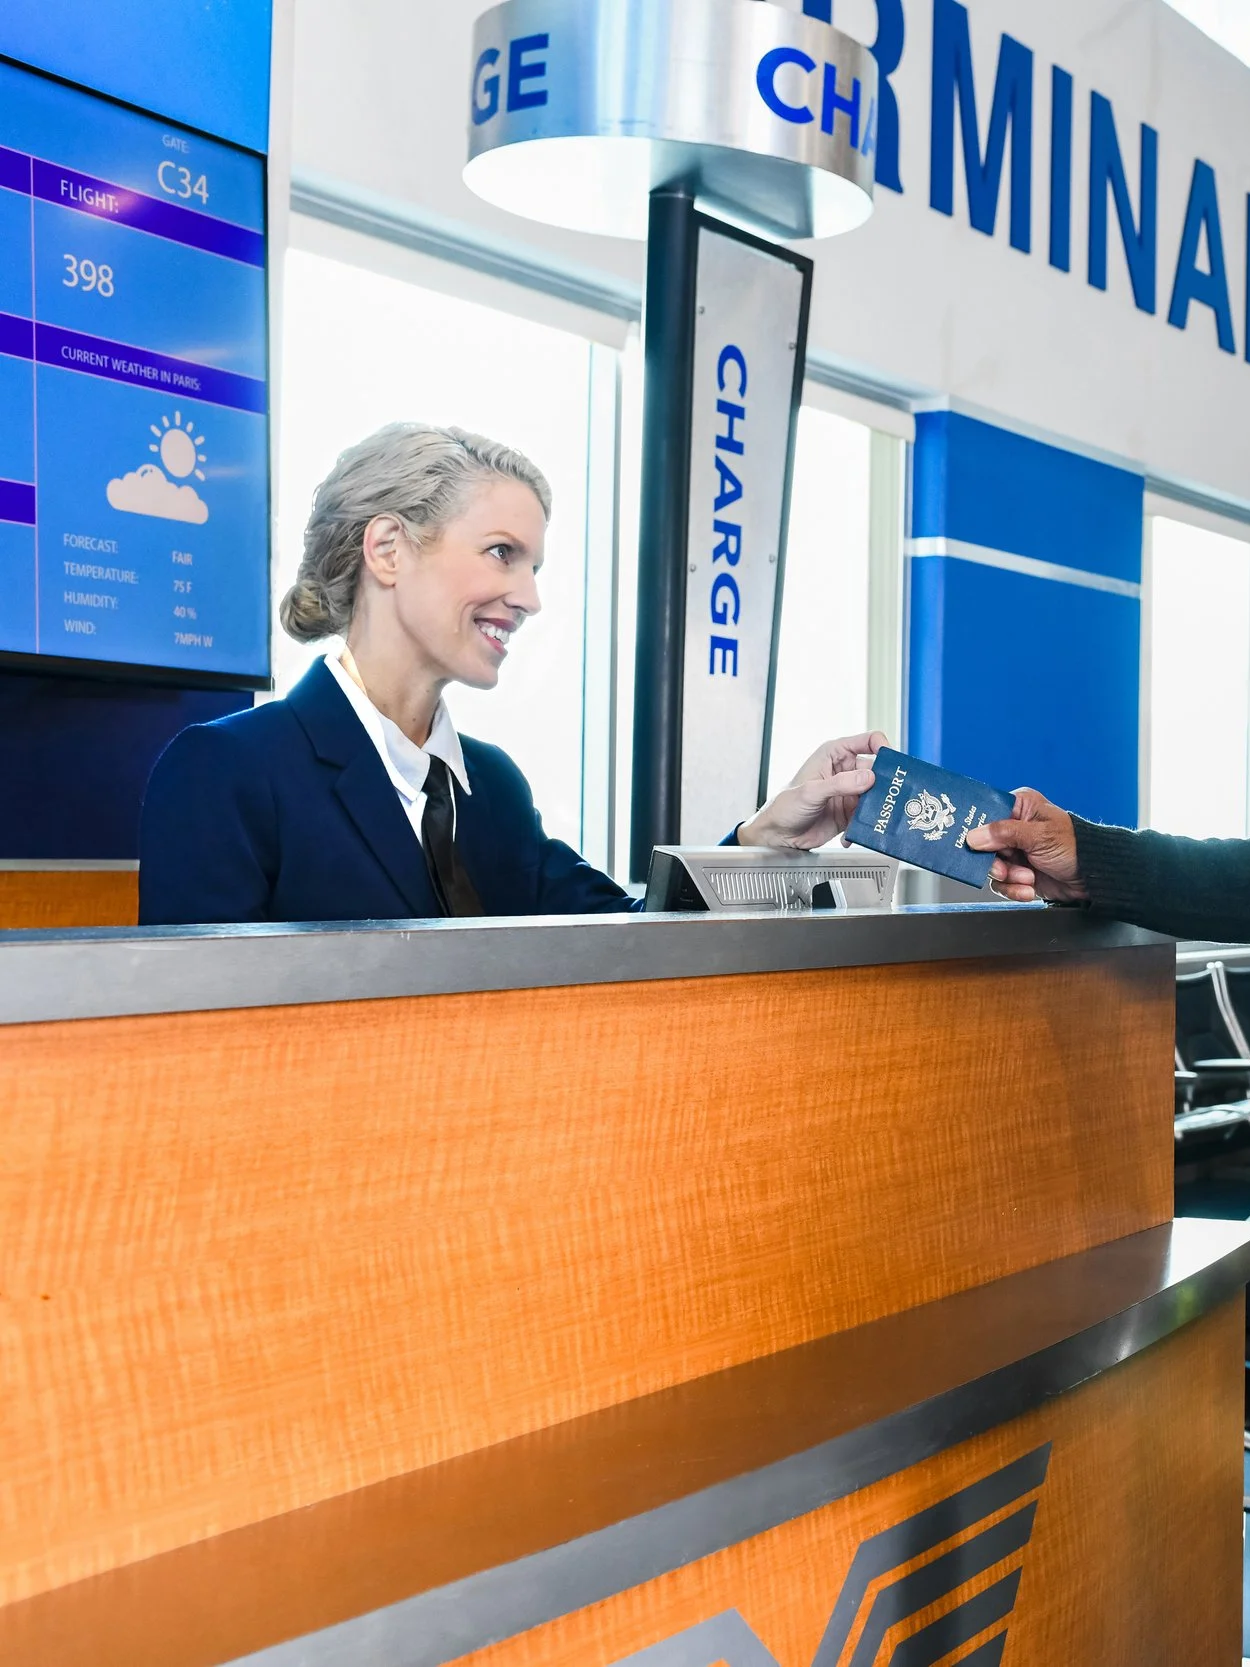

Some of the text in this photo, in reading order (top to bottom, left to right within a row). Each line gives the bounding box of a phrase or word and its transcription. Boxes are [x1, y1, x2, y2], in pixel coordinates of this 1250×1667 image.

[472, 33, 549, 126] GE
[60, 180, 119, 213] FLIGHT:
[157, 161, 209, 204] C34
[62, 254, 114, 297] 398
[61, 346, 109, 368] CURRENT
[111, 357, 159, 380] WEATHER
[160, 370, 171, 383] IN
[709, 345, 747, 677] CHARGE
[63, 533, 118, 553] FORECAST:
[172, 551, 193, 565] FAIR
[64, 561, 139, 584] TEMPERATURE:
[64, 591, 118, 609] HUMIDITY:
[173, 606, 186, 618] 40
[64, 619, 96, 635] WIND:
[174, 632, 213, 648] 7MPH W
[873, 765, 908, 835] PASSPORT
